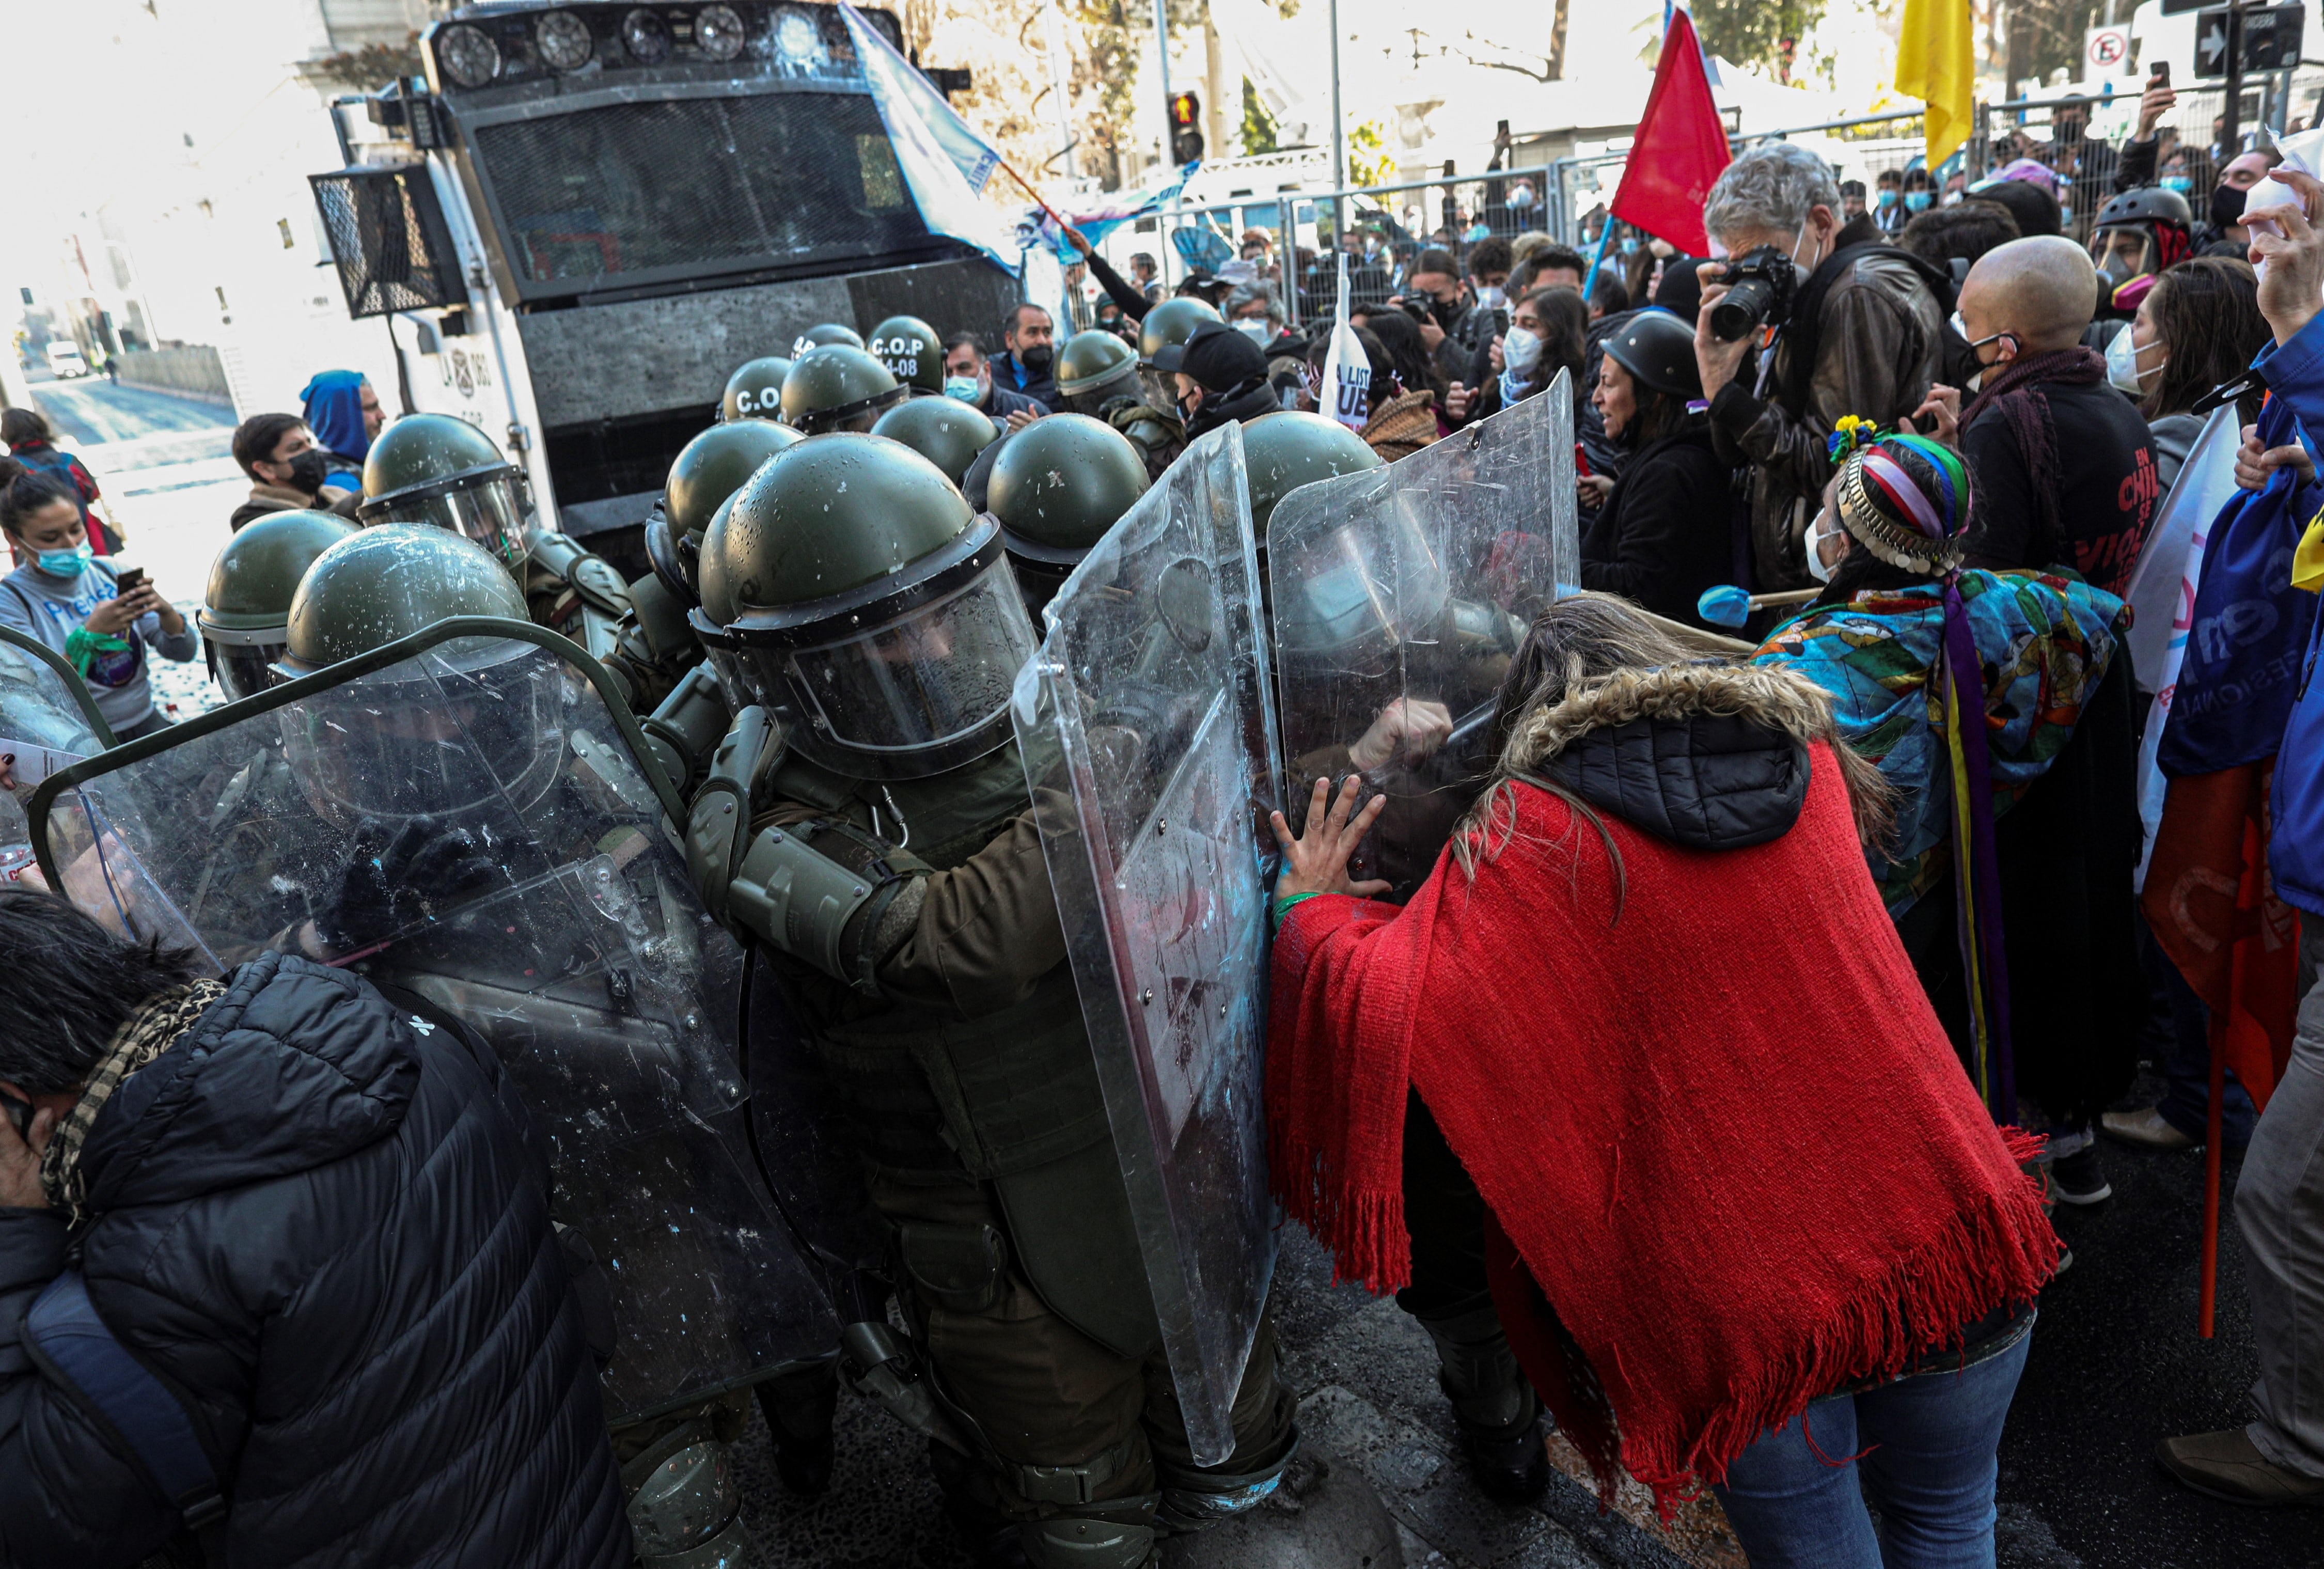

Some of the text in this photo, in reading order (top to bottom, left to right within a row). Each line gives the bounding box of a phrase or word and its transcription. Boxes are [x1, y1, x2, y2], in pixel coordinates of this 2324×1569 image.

[871, 337, 924, 356] C.O.P
[1347, 366, 1370, 387] LIST
[2134, 447, 2149, 467] EN
[2118, 463, 2160, 511] CHIL
